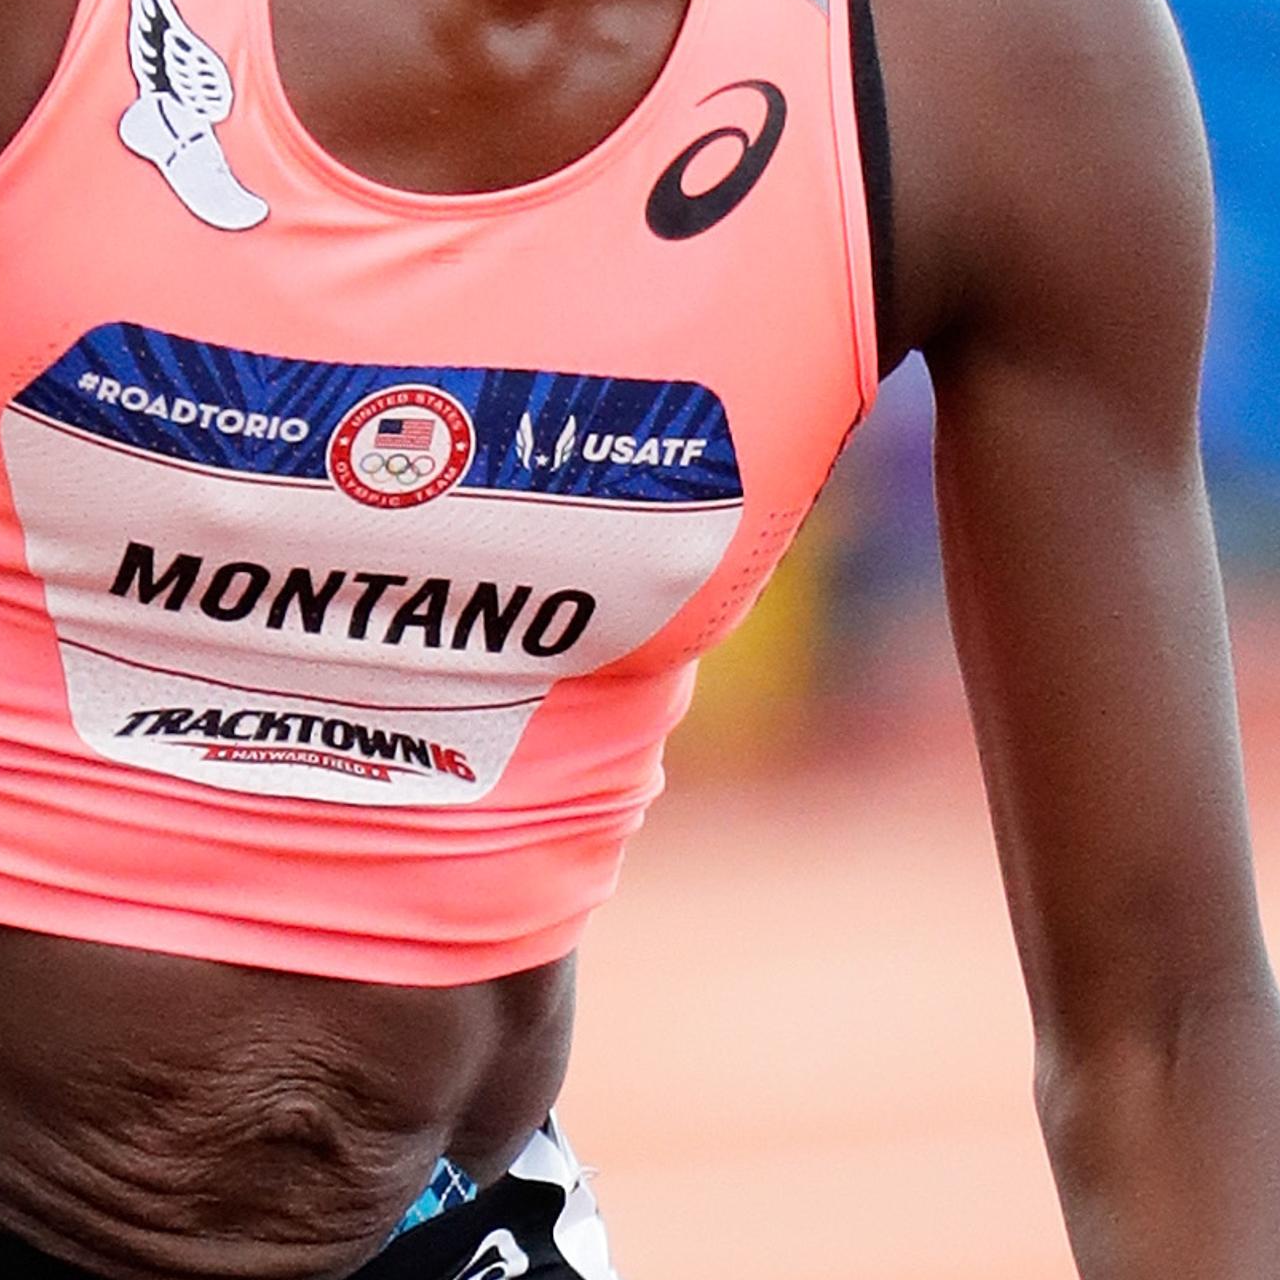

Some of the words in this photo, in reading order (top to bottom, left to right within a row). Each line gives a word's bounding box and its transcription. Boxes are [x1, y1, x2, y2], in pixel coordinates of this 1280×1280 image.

[77, 371, 310, 443] #ROADTORIO
[351, 393, 409, 428] UNITED
[415, 393, 464, 431] STATES
[582, 433, 707, 467] USATF
[336, 461, 401, 506] OLYMPIC
[416, 466, 457, 502] TEAM
[109, 541, 597, 658] MONTANO
[232, 750, 319, 764] HAYWARD
[322, 756, 365, 775] FIELD
